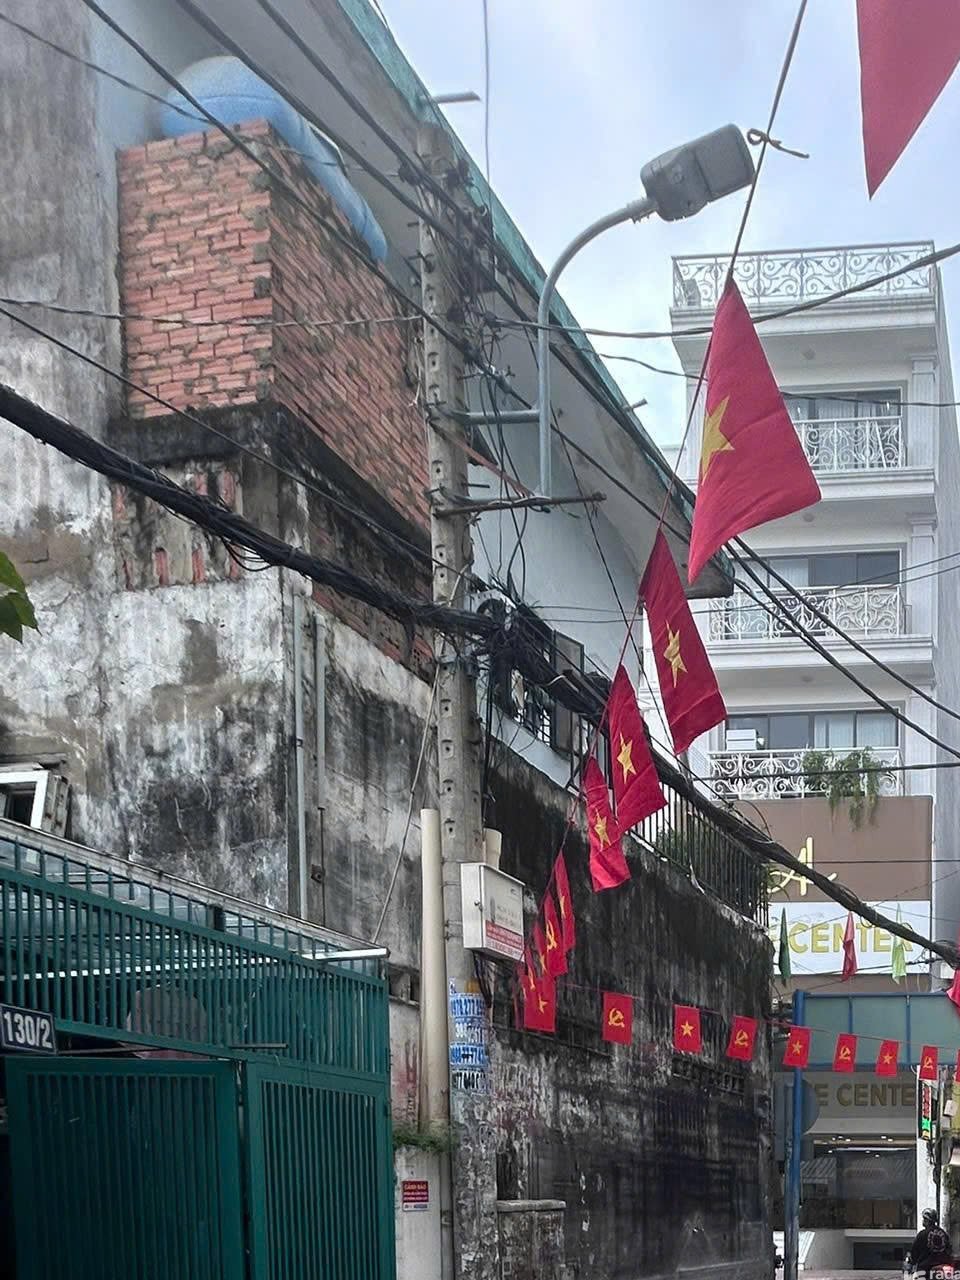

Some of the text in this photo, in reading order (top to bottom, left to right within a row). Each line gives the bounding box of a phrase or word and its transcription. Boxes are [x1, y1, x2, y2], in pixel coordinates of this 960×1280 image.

[789, 922, 914, 953] CENTE
[3, 1011, 53, 1049] 130/2
[837, 1083, 916, 1106] CENTE
